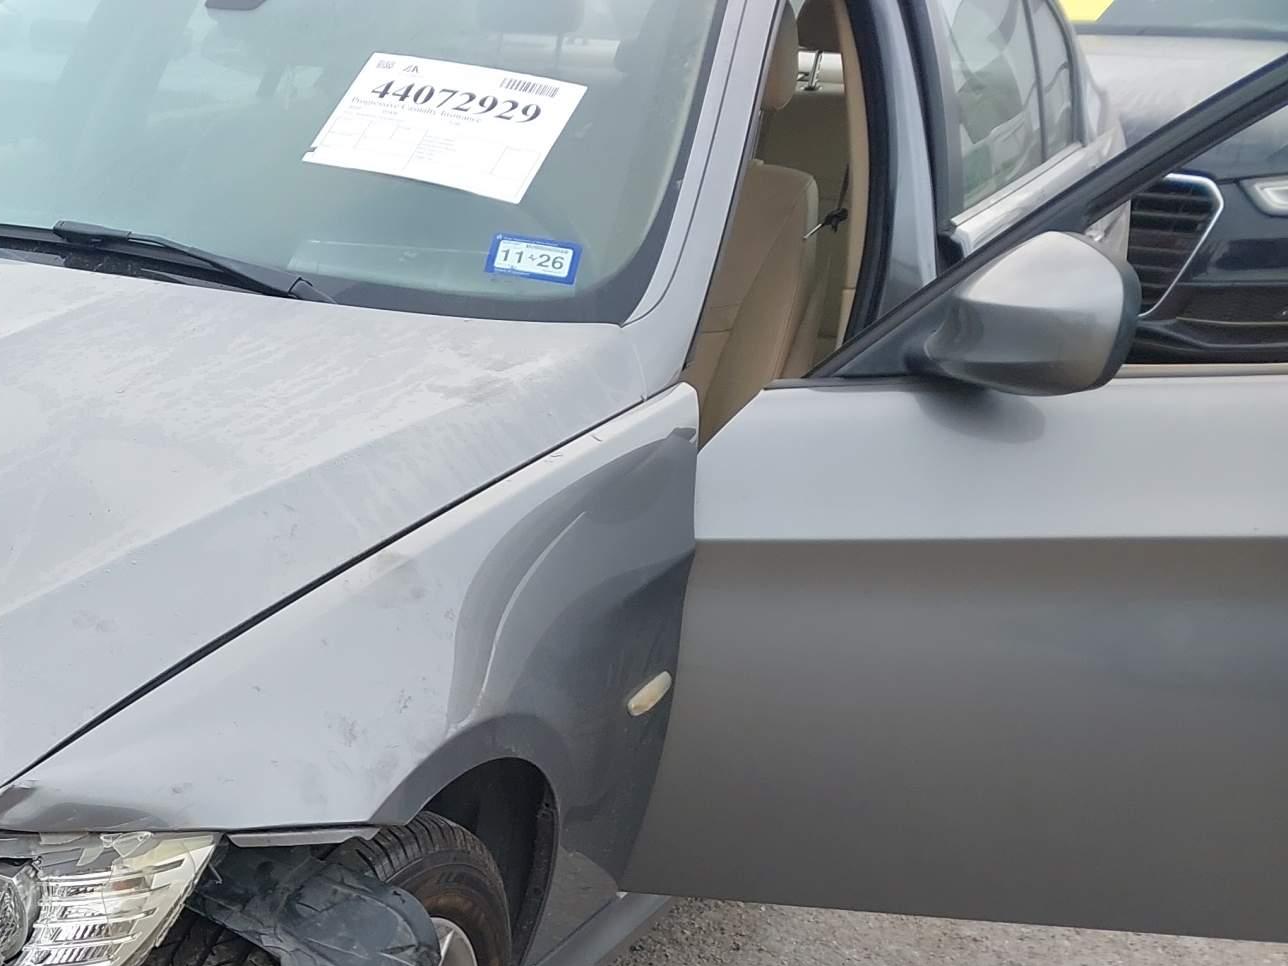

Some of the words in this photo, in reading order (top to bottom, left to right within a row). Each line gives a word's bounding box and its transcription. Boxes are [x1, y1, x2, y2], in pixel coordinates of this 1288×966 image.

[371, 79, 542, 124] 44072929
[501, 248, 524, 264] 11
[536, 253, 566, 270] 26
